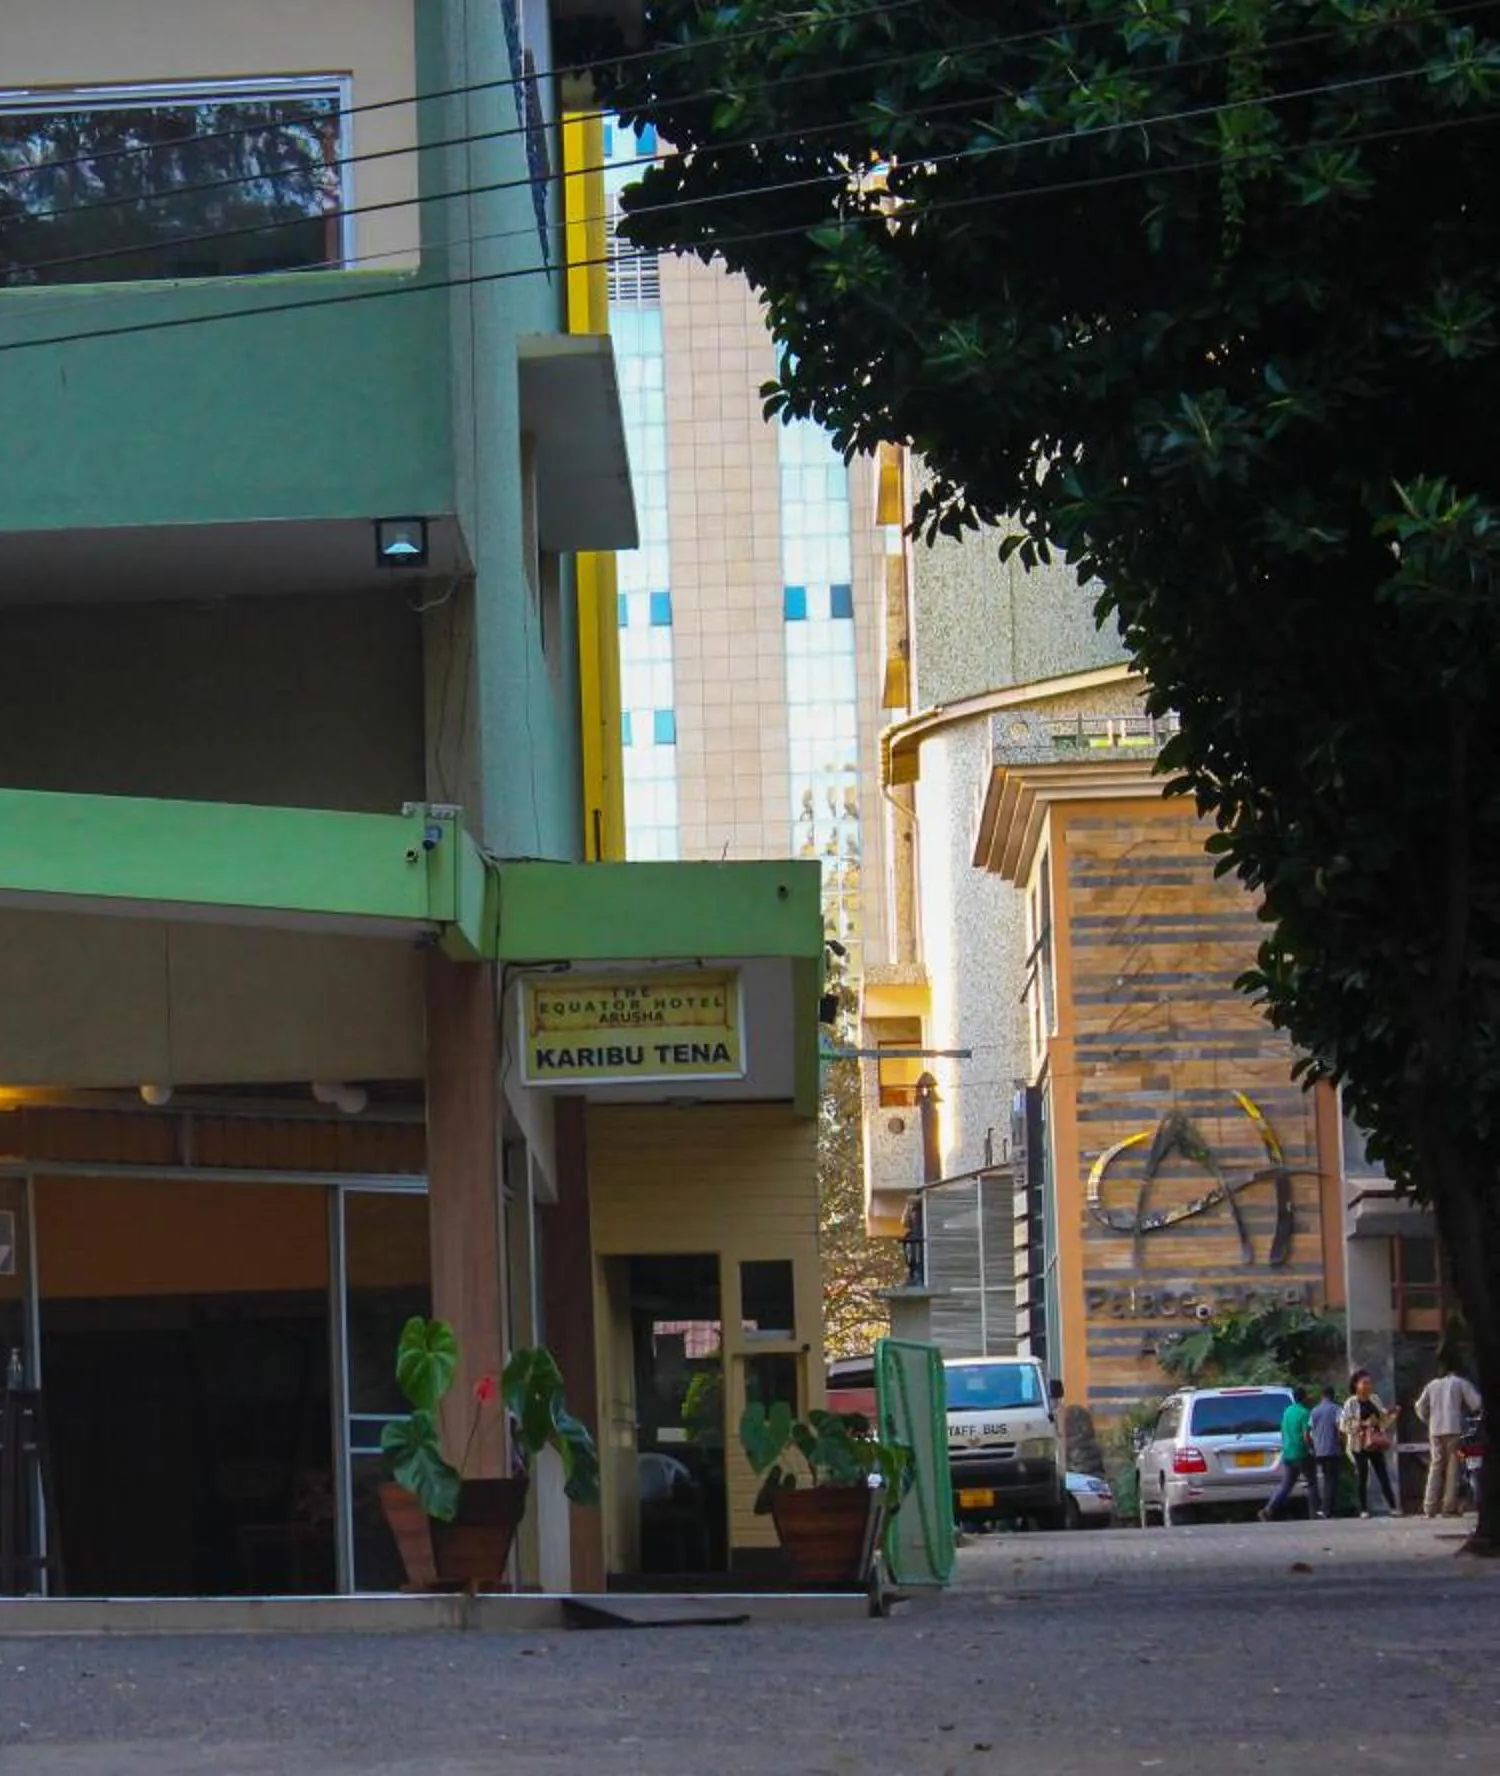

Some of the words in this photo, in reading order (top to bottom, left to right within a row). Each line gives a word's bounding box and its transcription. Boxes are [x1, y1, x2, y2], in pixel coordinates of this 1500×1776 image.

[611, 986, 651, 998] THE
[540, 999, 640, 1015] EQUATOR
[654, 997, 724, 1010] HOTEL
[599, 1010, 665, 1024] ARUSHA
[536, 1045, 644, 1070] KARIBU
[653, 1042, 731, 1064] TENA
[948, 1424, 977, 1437] TAFF
[983, 1422, 1008, 1435] BUS
